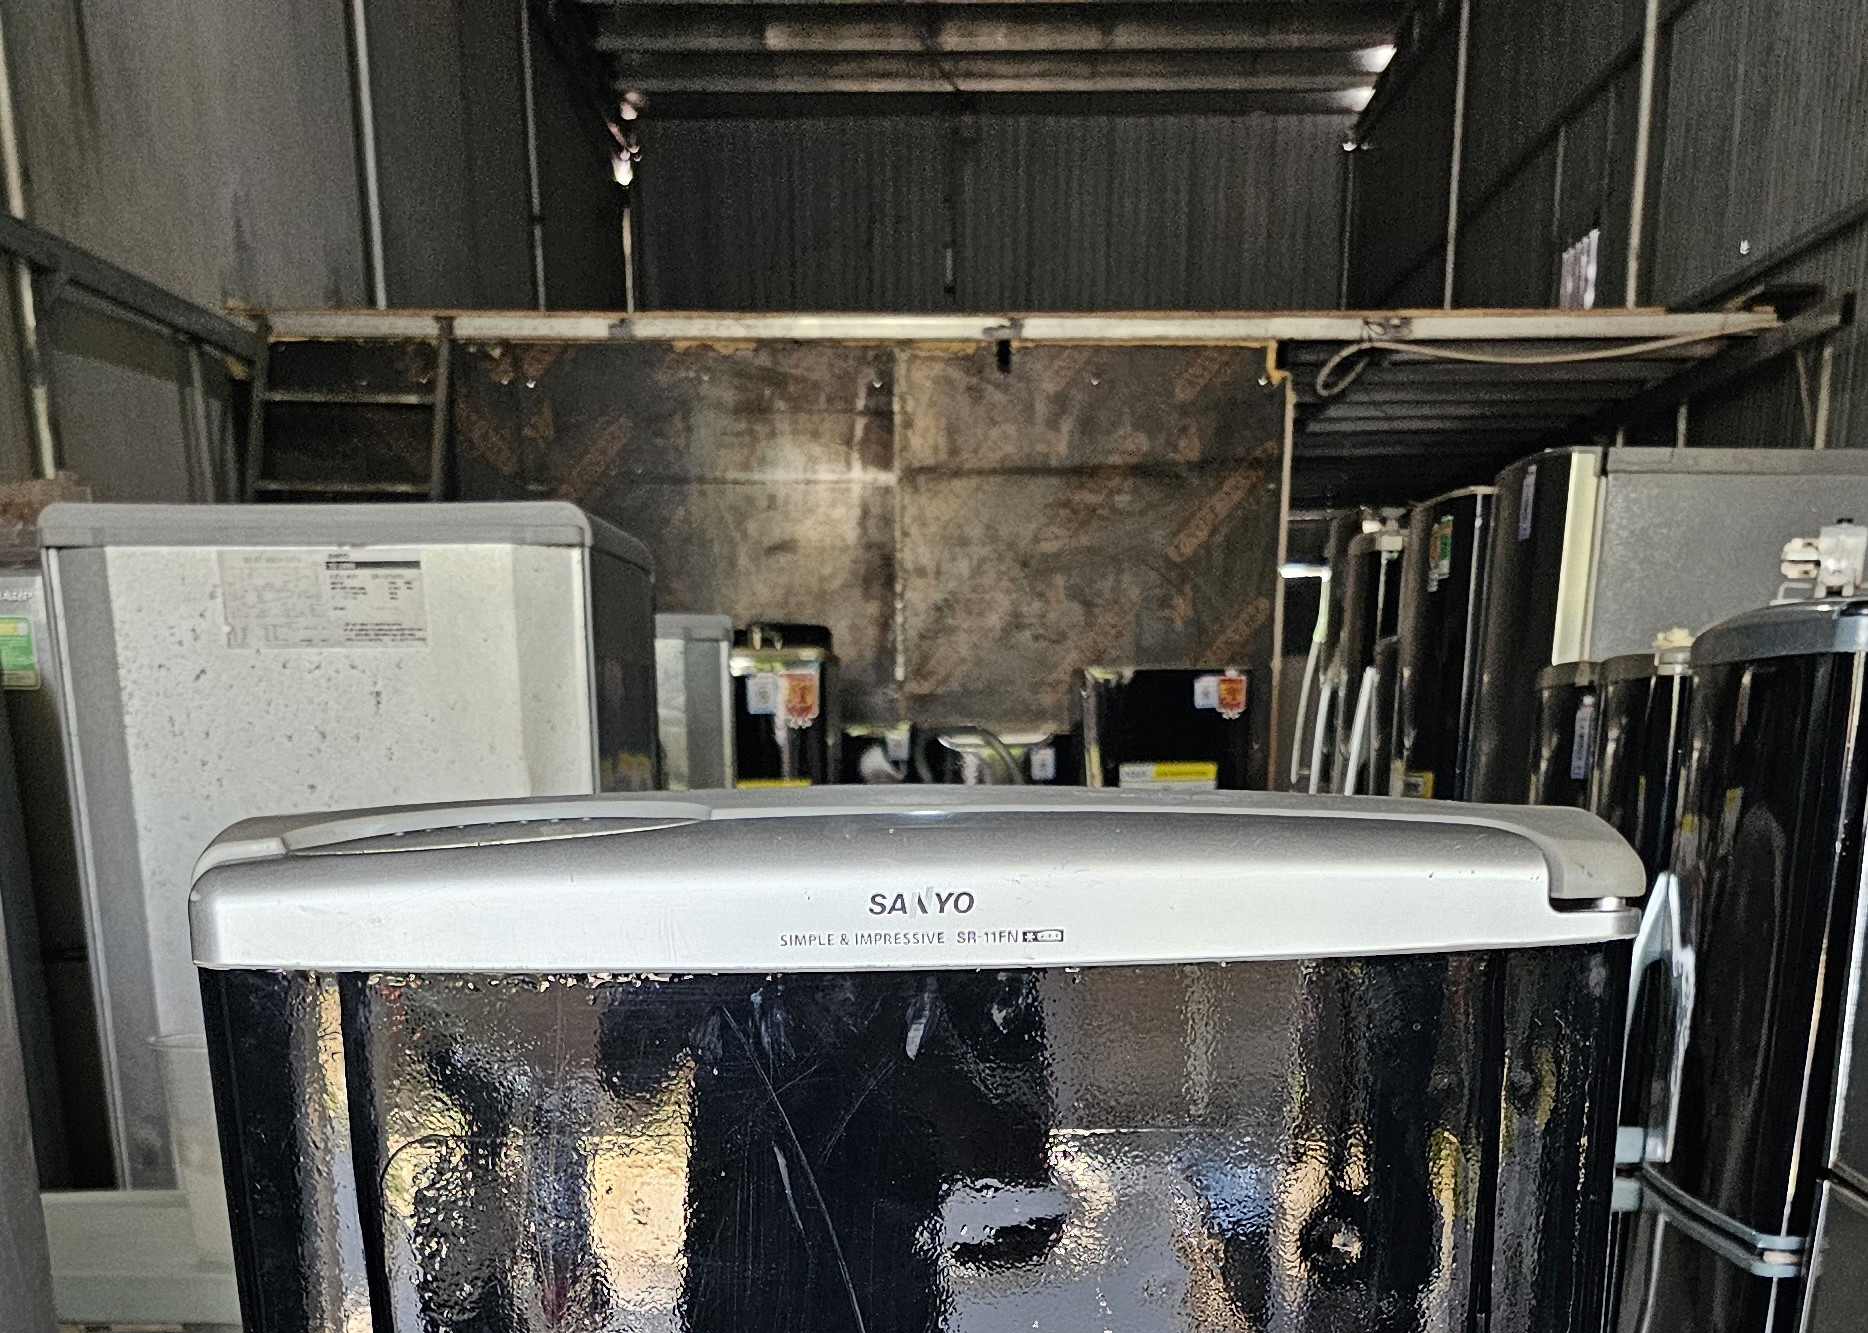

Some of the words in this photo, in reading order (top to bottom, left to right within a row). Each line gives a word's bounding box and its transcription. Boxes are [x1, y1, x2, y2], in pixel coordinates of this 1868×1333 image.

[868, 886, 975, 919] SANYO
[780, 933, 835, 947] SIMPLE
[840, 932, 850, 946] &
[855, 931, 945, 946] IMPRESSIVE
[956, 929, 1018, 944] SR-11FN
